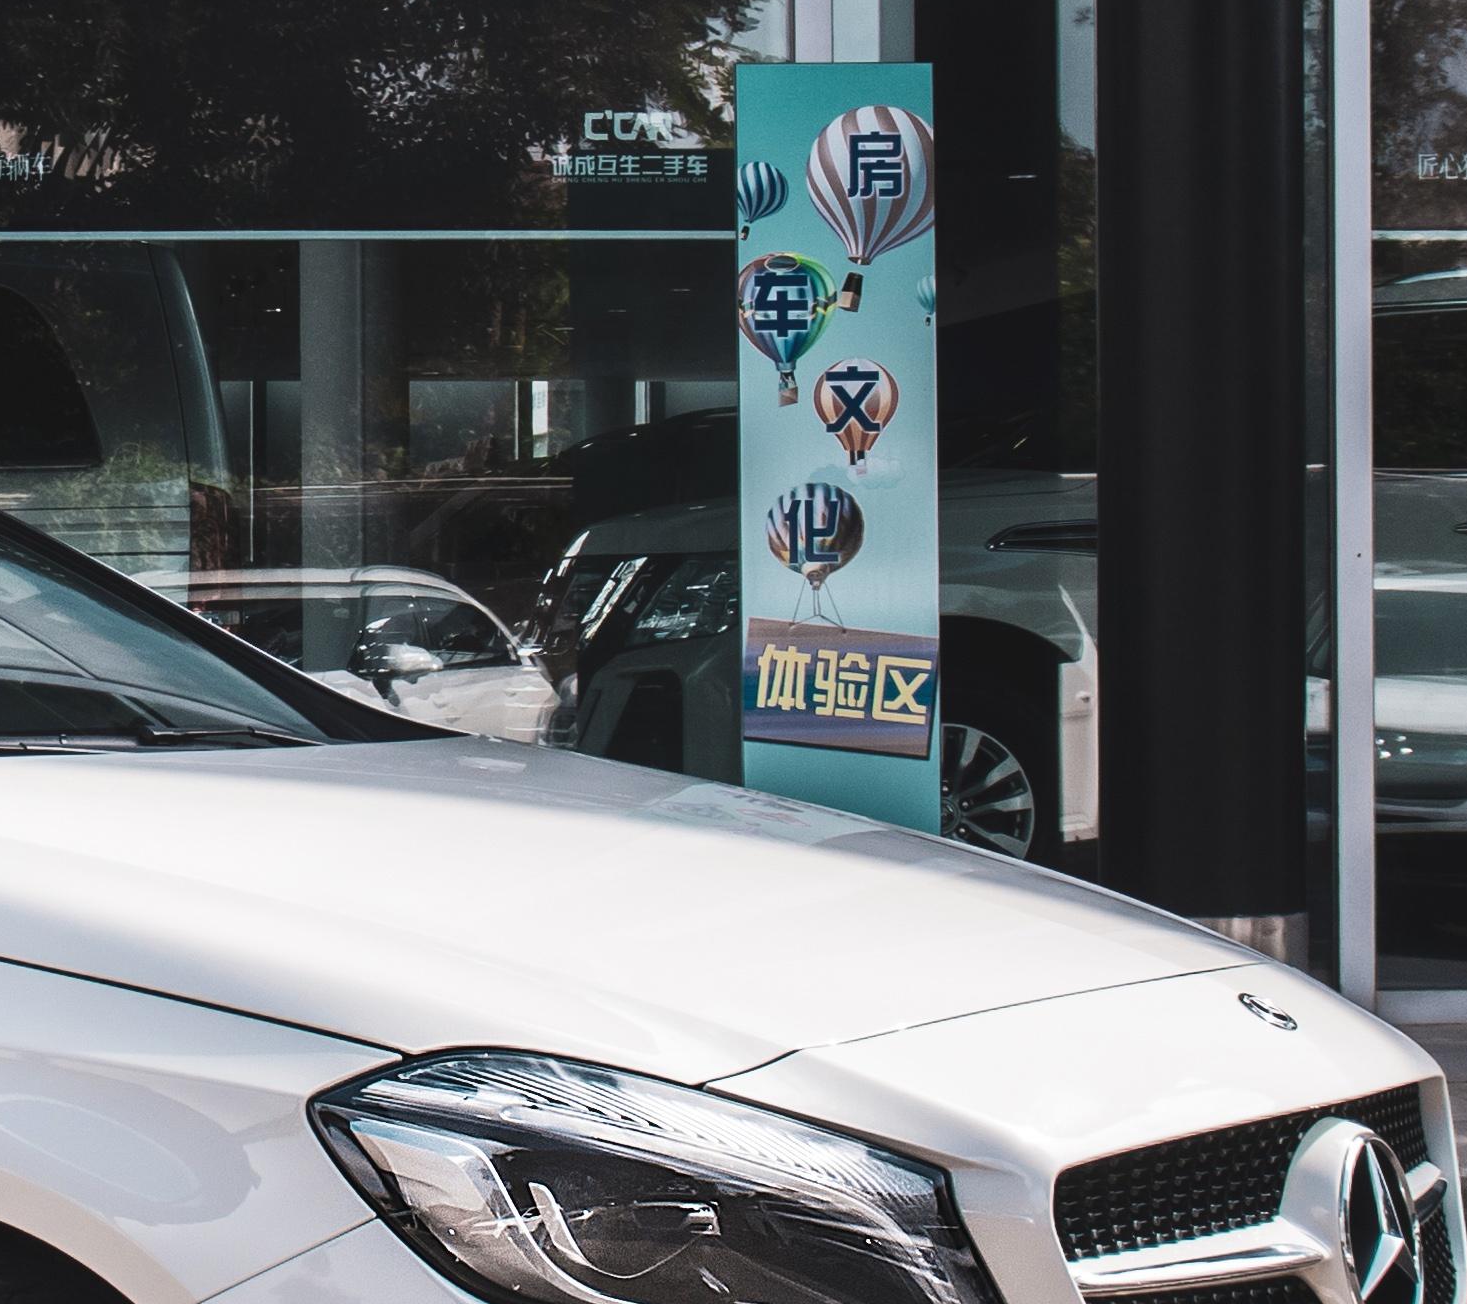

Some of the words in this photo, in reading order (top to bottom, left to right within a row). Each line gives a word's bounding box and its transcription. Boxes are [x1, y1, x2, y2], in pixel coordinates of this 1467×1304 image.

[551, 155, 709, 176] 诚成互生二手车
[756, 643, 933, 725] 体验区
